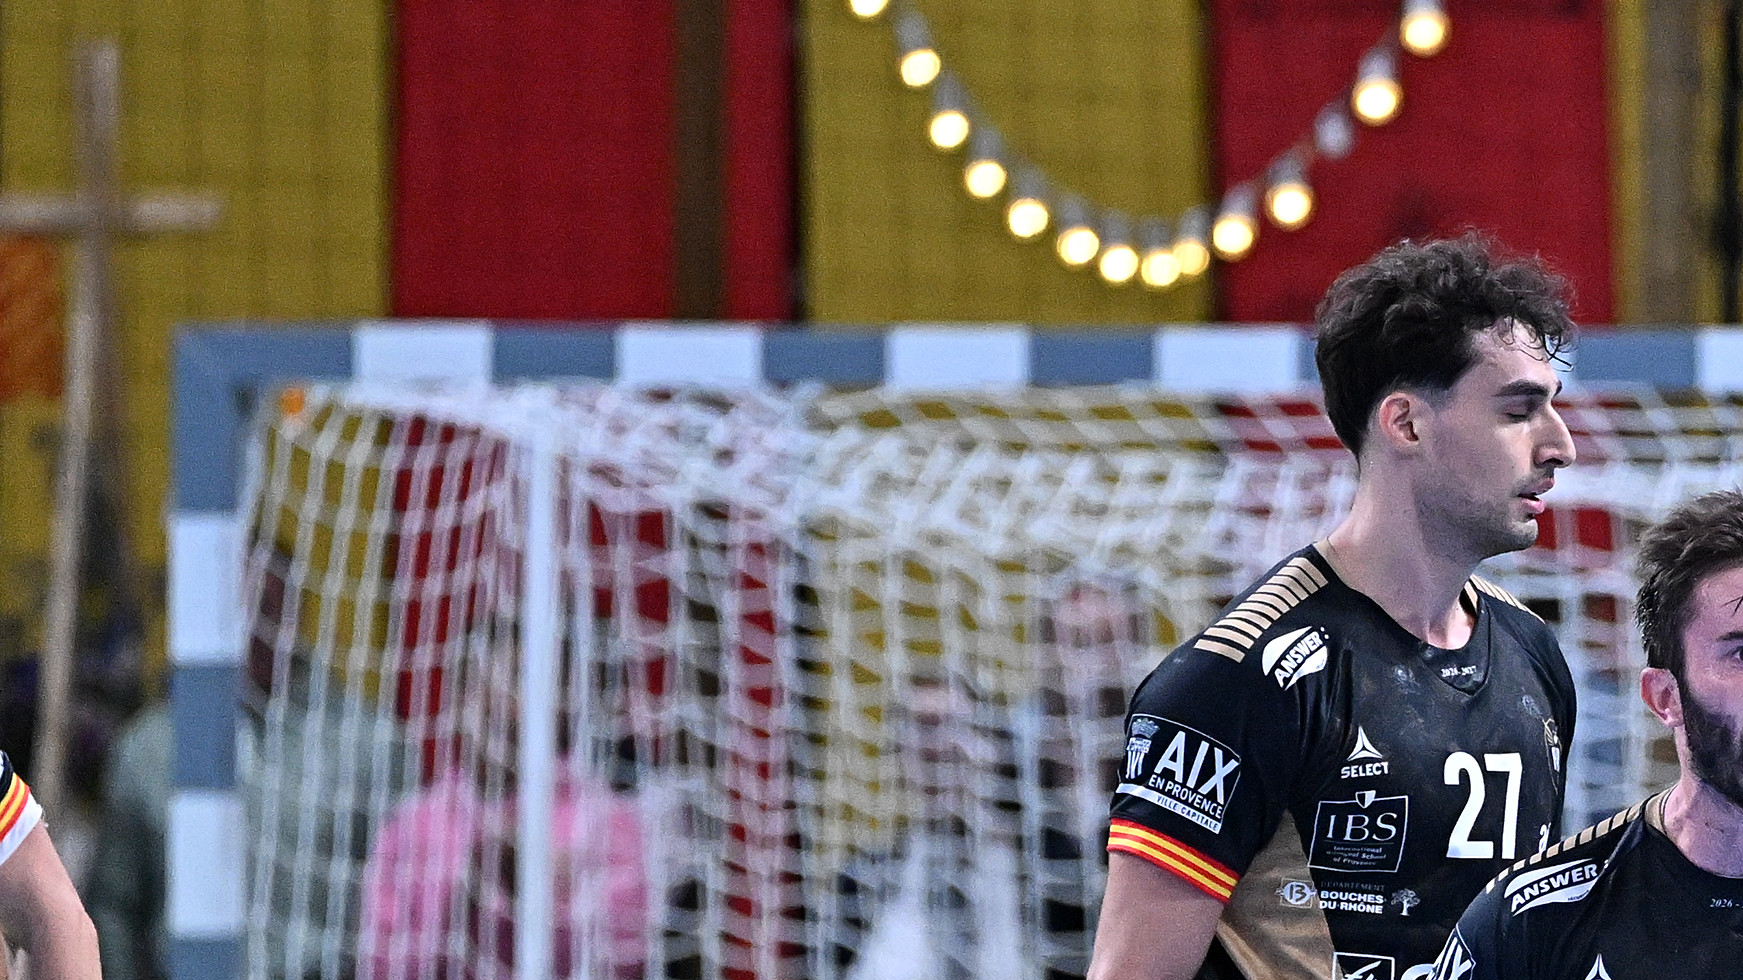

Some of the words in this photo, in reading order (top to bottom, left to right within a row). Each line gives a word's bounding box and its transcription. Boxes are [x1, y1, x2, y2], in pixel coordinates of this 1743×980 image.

[1274, 631, 1324, 688] ANSWER
[1153, 730, 1240, 805] AIX
[1341, 761, 1388, 778] SELECT
[1148, 774, 1165, 790] EN
[1165, 781, 1223, 819] PROVENCE
[1157, 794, 1178, 810] VILLE
[1180, 807, 1219, 832] CAPITALE
[1444, 752, 1523, 859] 27
[1326, 812, 1398, 841] IBS
[1511, 863, 1598, 912] ANSWER
[1710, 898, 1733, 908] 2026
